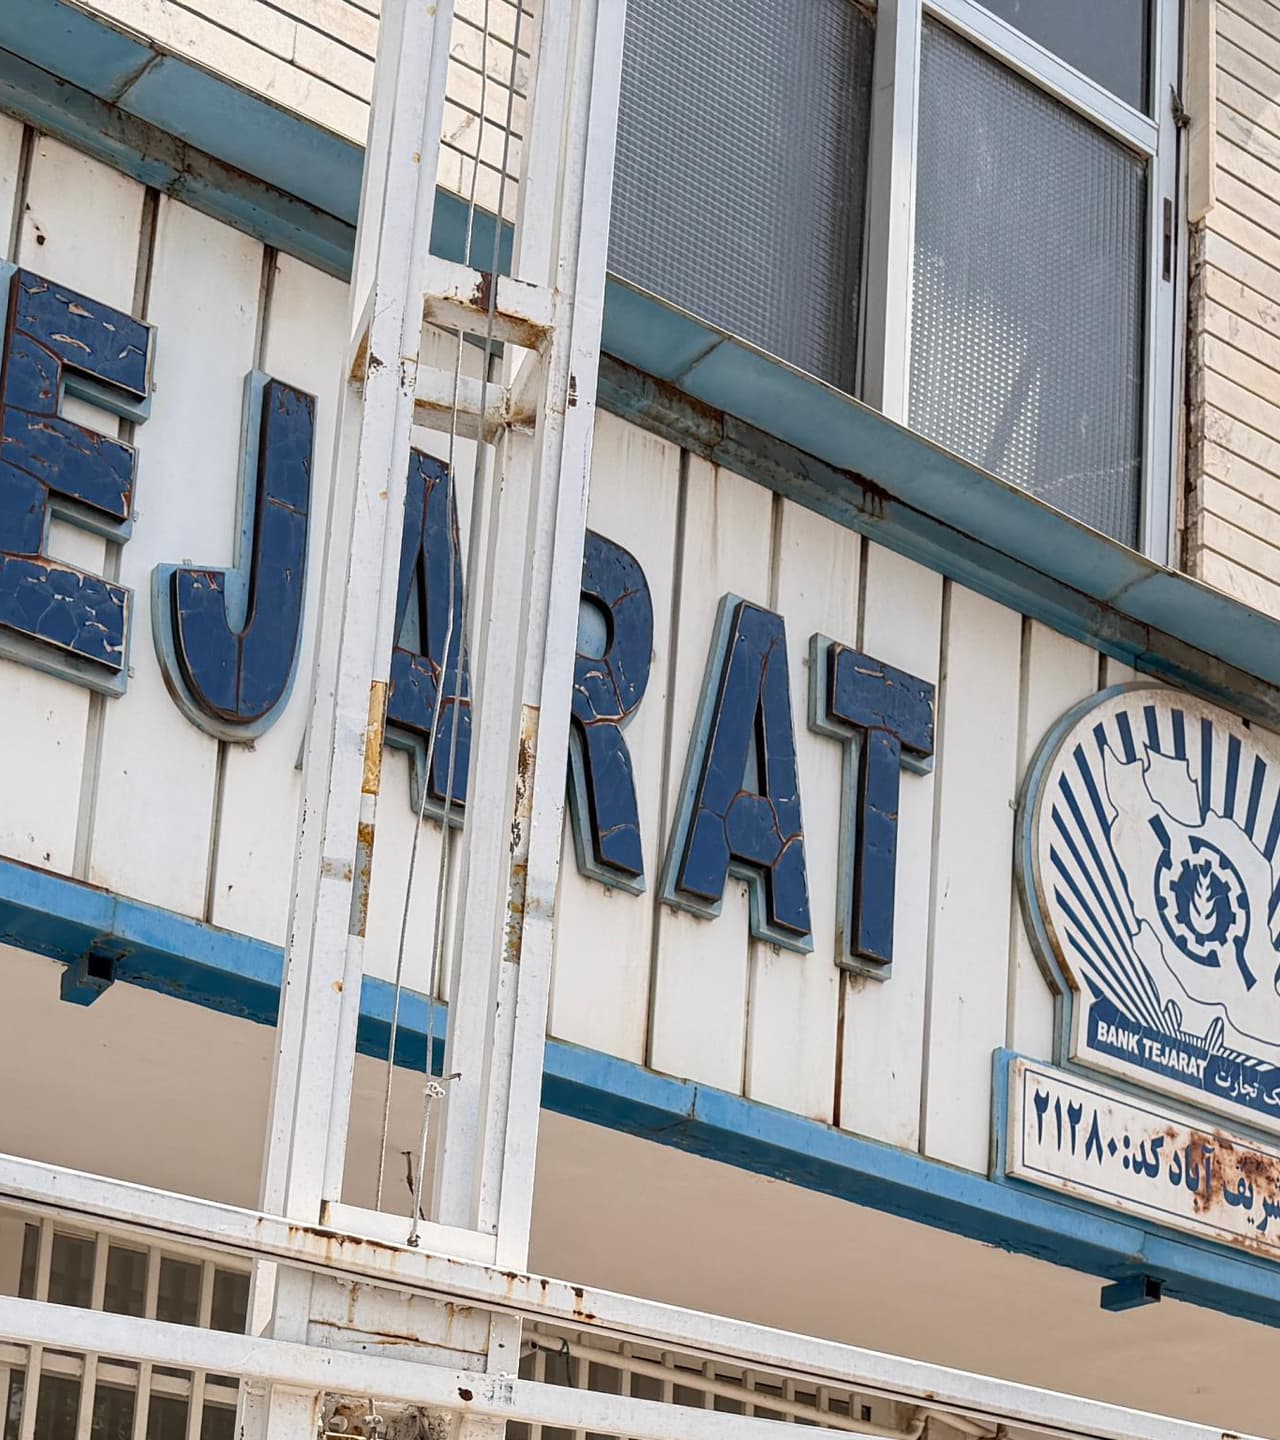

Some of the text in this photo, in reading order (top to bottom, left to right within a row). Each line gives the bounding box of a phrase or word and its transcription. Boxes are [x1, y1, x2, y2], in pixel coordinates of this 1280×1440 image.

[1097, 1020, 1208, 1079] BANK TEJARAT
[1215, 1067, 1258, 1099] تجارت
[1169, 1145, 1216, 1208] آباد
